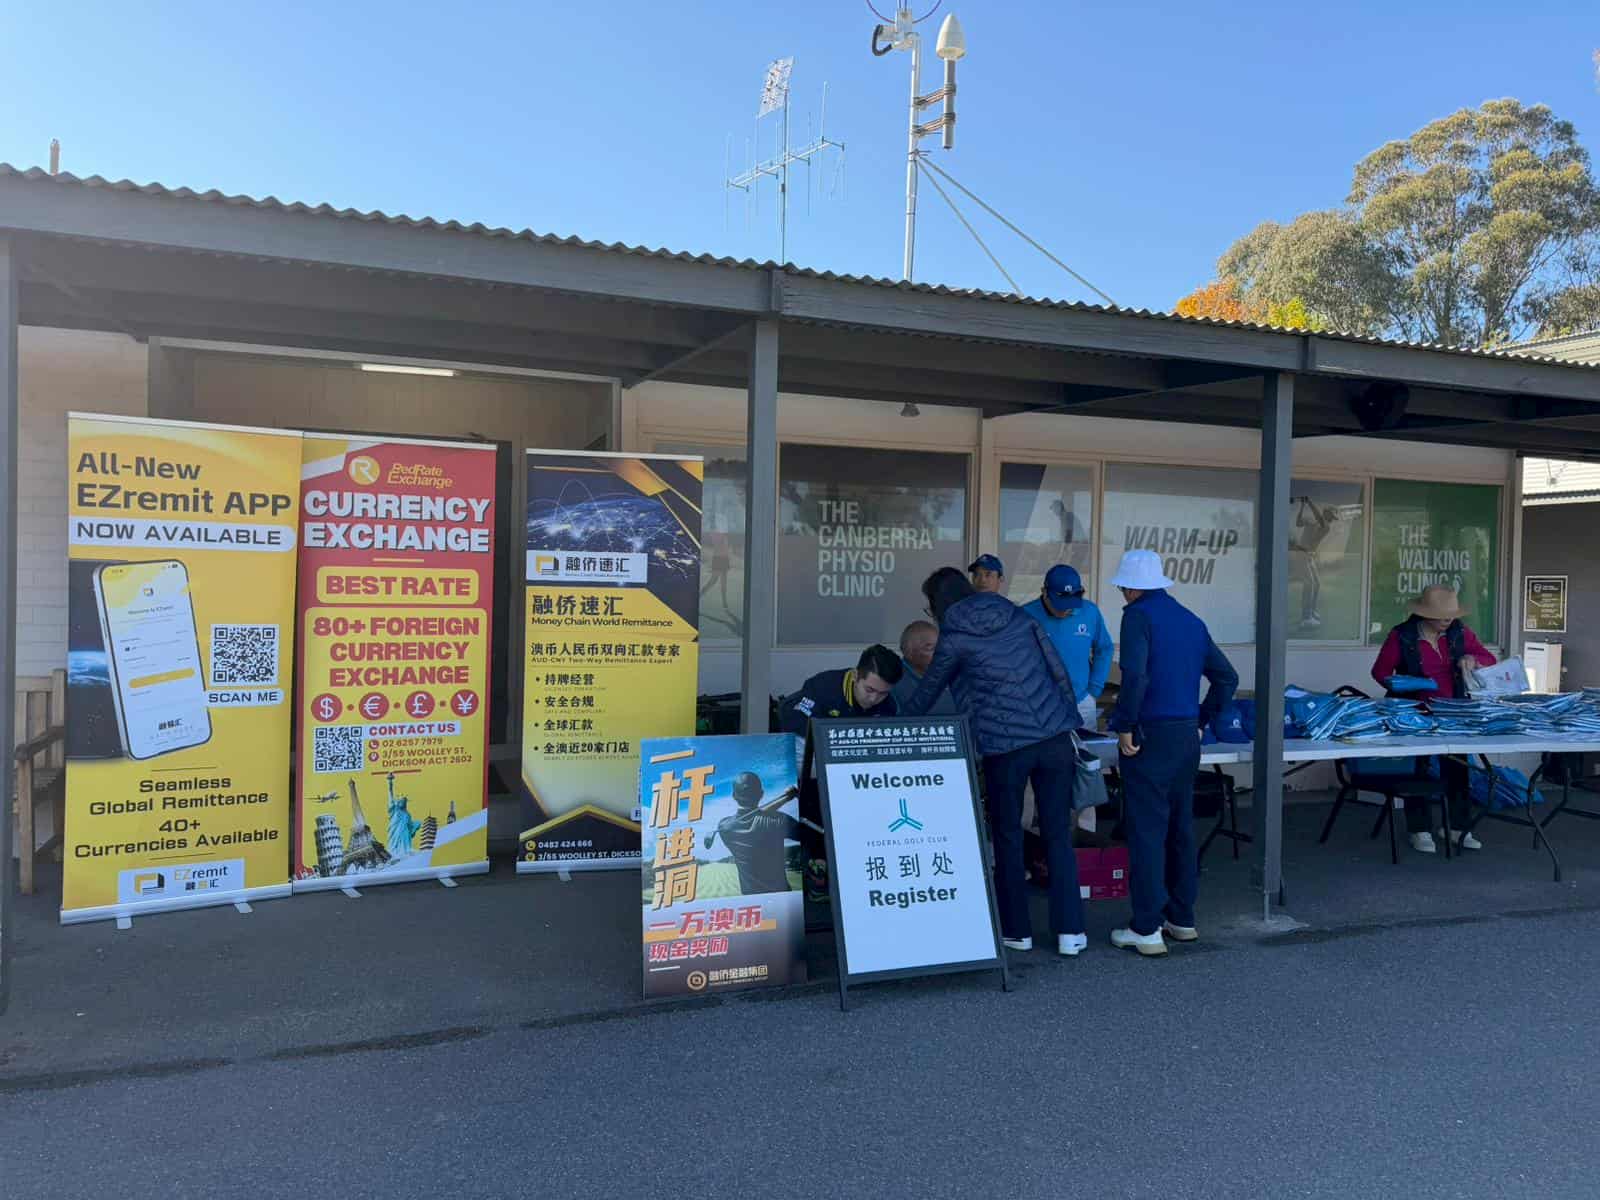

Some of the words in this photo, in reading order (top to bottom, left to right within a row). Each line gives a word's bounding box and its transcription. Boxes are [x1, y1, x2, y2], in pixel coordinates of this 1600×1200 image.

[77, 452, 201, 480] All-New
[387, 471, 453, 489] Exchange
[77, 483, 214, 513] EZremit
[224, 491, 291, 516] APP
[304, 490, 490, 523] CURRENCY
[818, 500, 859, 523] THE
[77, 522, 134, 540] NOW
[145, 525, 281, 545] AVAILABLE
[303, 522, 490, 553] EXCHANGE
[818, 526, 934, 550] CANBERRA
[1124, 525, 1239, 555] WARM-UP
[1399, 524, 1431, 546] THE
[566, 557, 630, 573] 融侨速汇
[818, 551, 895, 573] PHYSIO
[1399, 548, 1471, 570] WALKING
[1163, 557, 1216, 584] OOM
[326, 576, 398, 595] BEST
[401, 577, 471, 596] RATE
[818, 575, 885, 597] CLINIC
[532, 594, 624, 616] 融侨速汇
[313, 617, 366, 636] 80+
[370, 617, 480, 636] FOREIGN
[531, 617, 562, 627] Money
[564, 617, 591, 626] Chain
[593, 618, 620, 627] World
[622, 618, 673, 627] Remittance
[329, 641, 470, 662] CURRENCY
[531, 642, 680, 657] 澳币人民币双向汇款专家
[329, 666, 470, 687] EXCHANGE
[545, 673, 594, 685] 持牌经营
[208, 692, 251, 703] SCAN
[257, 691, 278, 702] ME
[545, 696, 594, 707] 安全合规
[369, 724, 435, 736] CONTACT
[437, 723, 455, 733] US
[544, 719, 593, 730] 全球汇款
[407, 747, 452, 757] WOOLLEY
[544, 741, 630, 753] 全澳近20家门店
[382, 758, 426, 768] DICKSON
[428, 757, 447, 765] ACT
[139, 777, 232, 793] Seamless
[851, 772, 944, 789] Welcome
[90, 798, 153, 816] Global
[162, 792, 268, 811] Remittance
[159, 819, 201, 833] 40+
[75, 838, 188, 858] Currencies
[195, 828, 279, 847] Available
[865, 851, 954, 881] 报到处
[869, 886, 957, 908] Register
[650, 905, 762, 937] 一万澳币
[649, 937, 728, 962] 现金奖励
